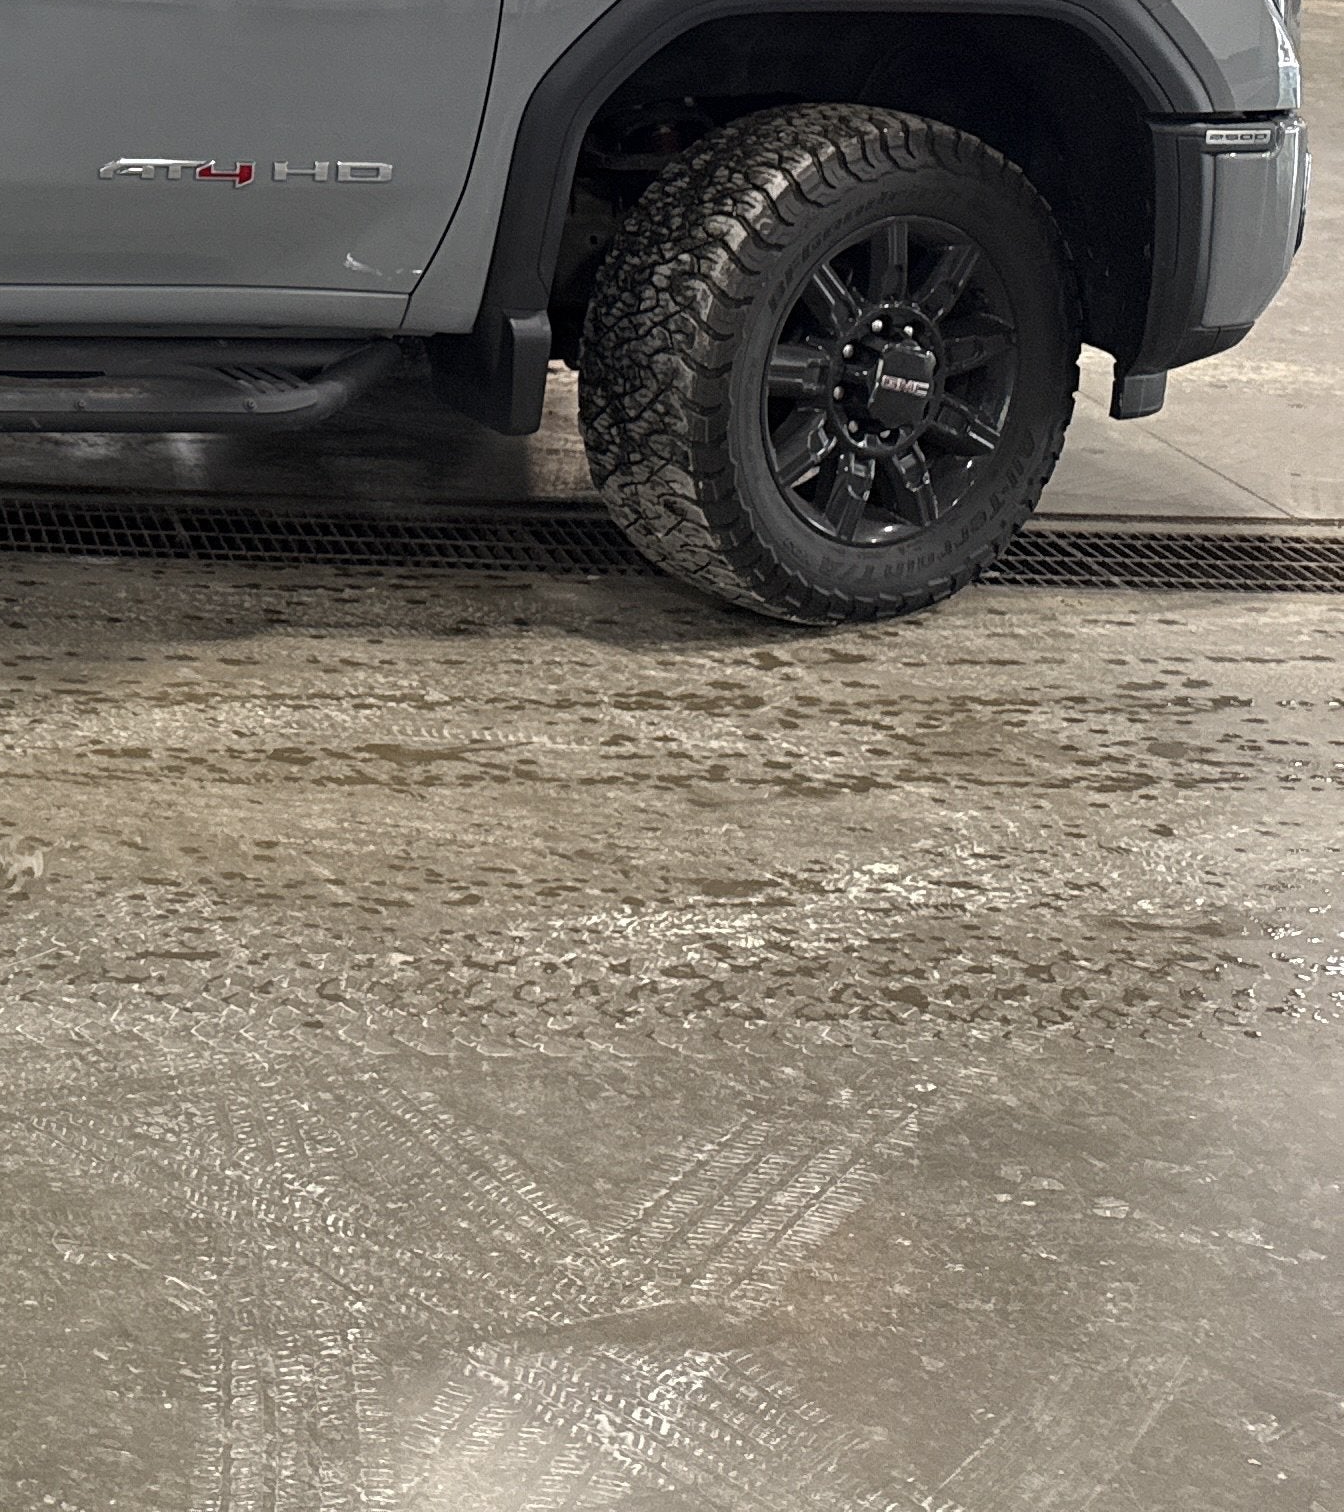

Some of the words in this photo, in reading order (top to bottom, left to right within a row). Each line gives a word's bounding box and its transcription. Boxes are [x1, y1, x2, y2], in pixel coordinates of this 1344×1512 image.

[98, 158, 256, 188] AT4
[272, 160, 393, 182] HD
[881, 374, 929, 397] GMC
